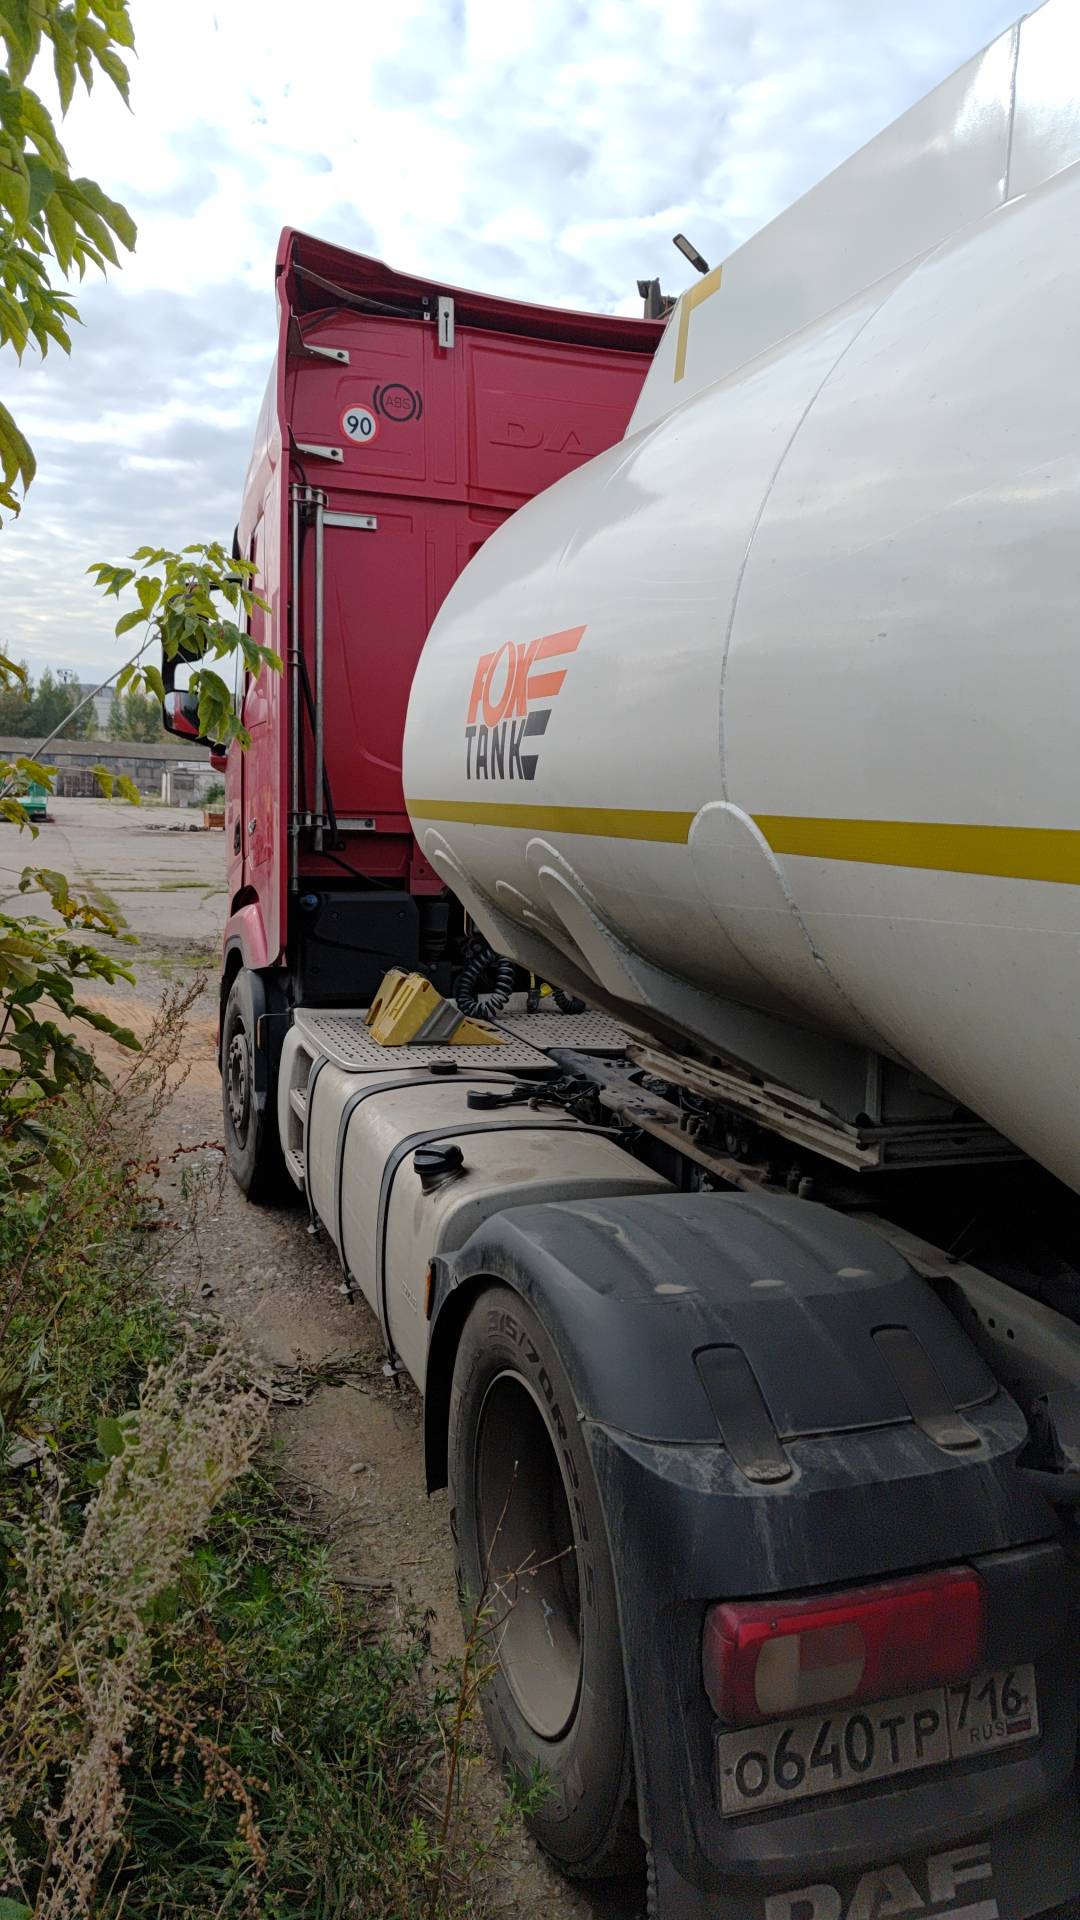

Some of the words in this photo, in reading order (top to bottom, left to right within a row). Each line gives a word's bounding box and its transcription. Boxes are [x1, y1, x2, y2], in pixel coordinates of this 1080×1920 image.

[385, 394, 412, 410] ABS
[346, 415, 372, 436] 90
[489, 421, 598, 457] DA
[466, 637, 543, 728] FOX
[465, 718, 526, 780] TANK
[951, 1671, 1023, 1731] 716
[969, 1723, 1006, 1743] RUS
